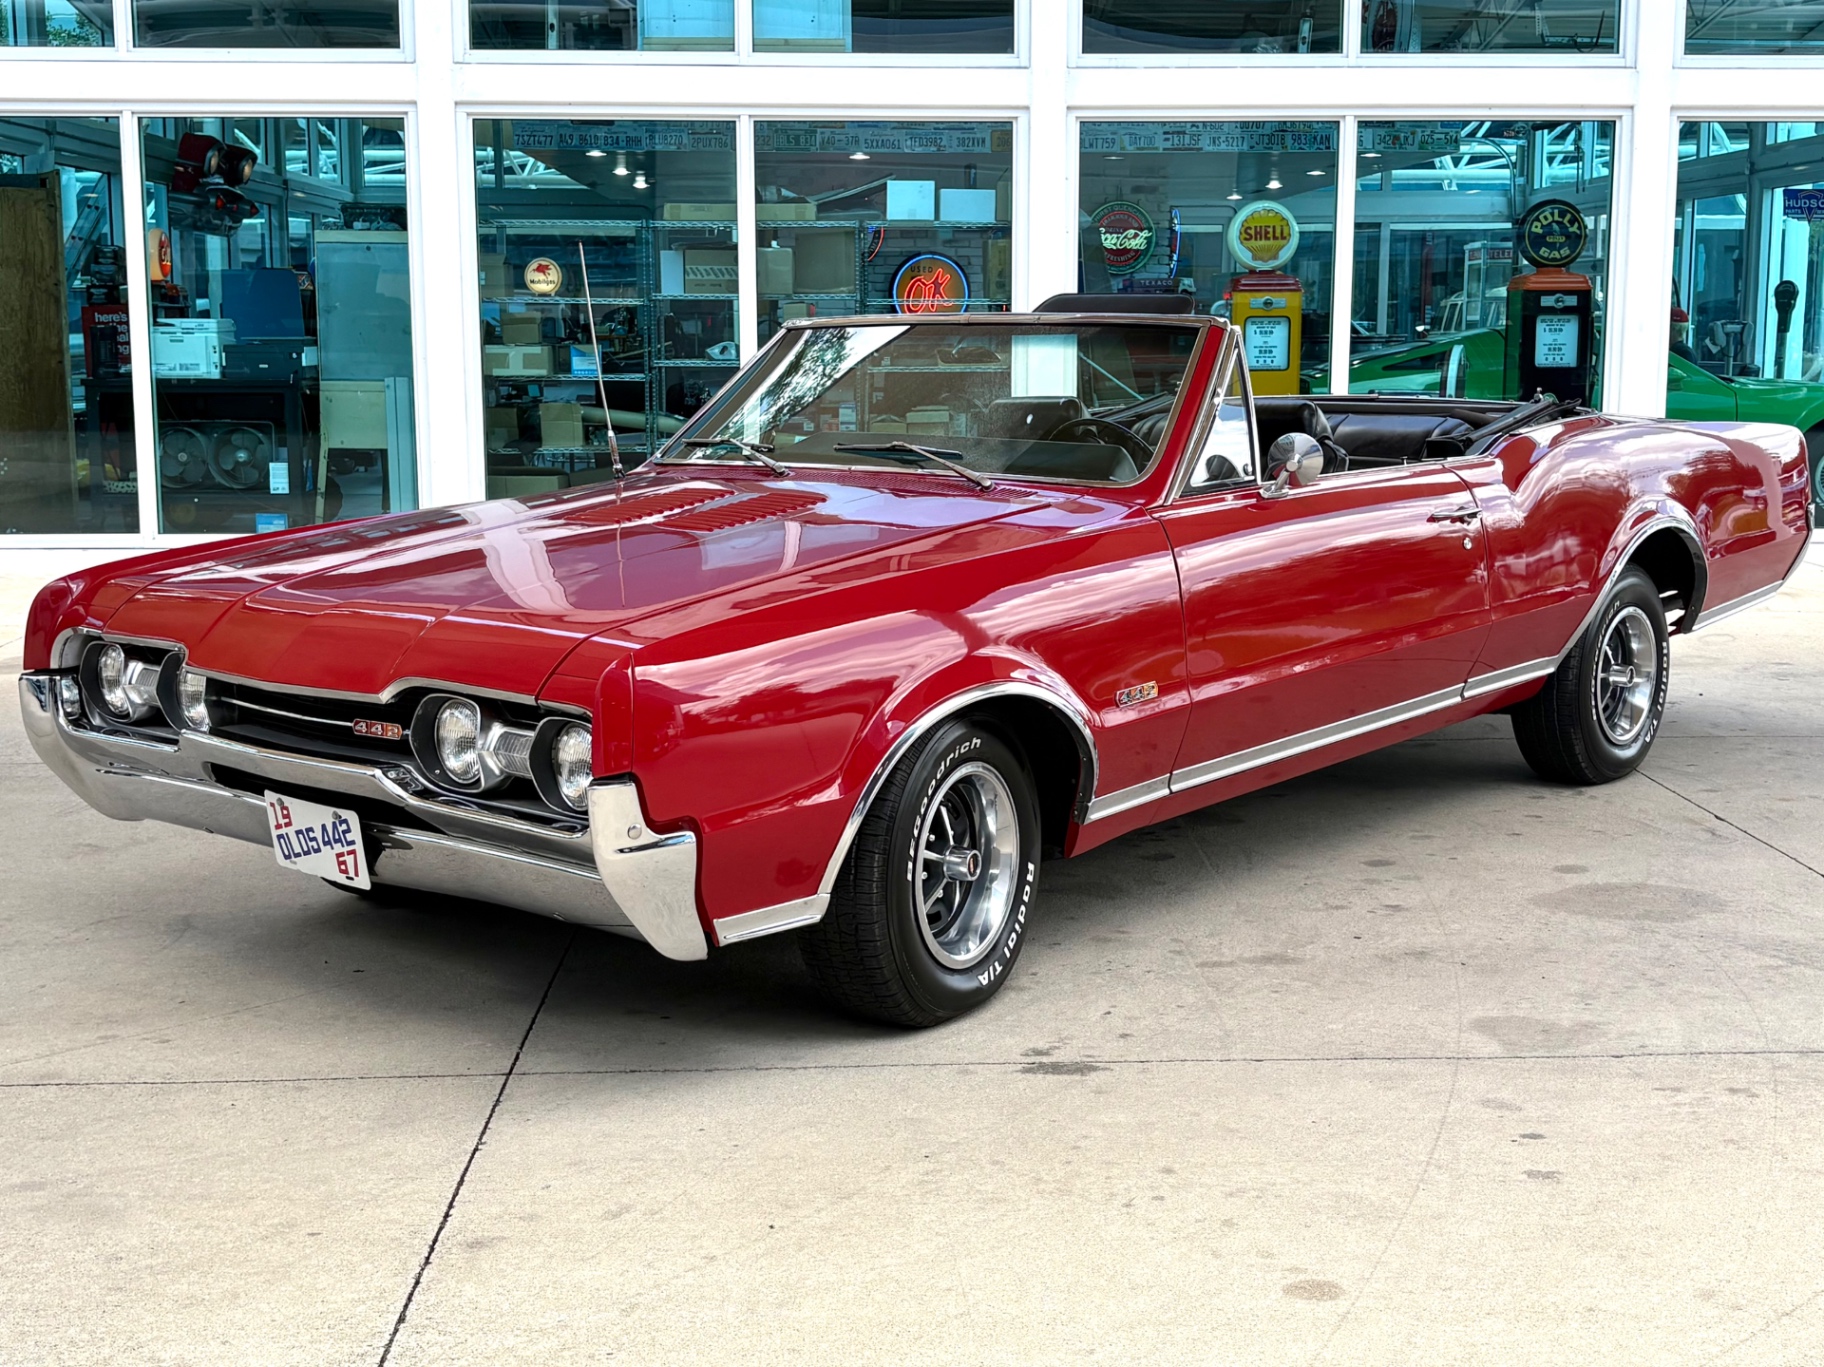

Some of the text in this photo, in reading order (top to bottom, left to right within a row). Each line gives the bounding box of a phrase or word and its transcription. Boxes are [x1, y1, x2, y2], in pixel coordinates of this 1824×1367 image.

[1243, 224, 1288, 242] SHELL
[1530, 208, 1581, 235] POLLY
[1538, 246, 1571, 259] GAS
[910, 265, 934, 274] USED
[94, 311, 128, 323] here's
[269, 801, 293, 831] 19
[276, 818, 357, 861] OLDS 442
[335, 848, 360, 878] 67
[977, 861, 1035, 986] Radial T/A
